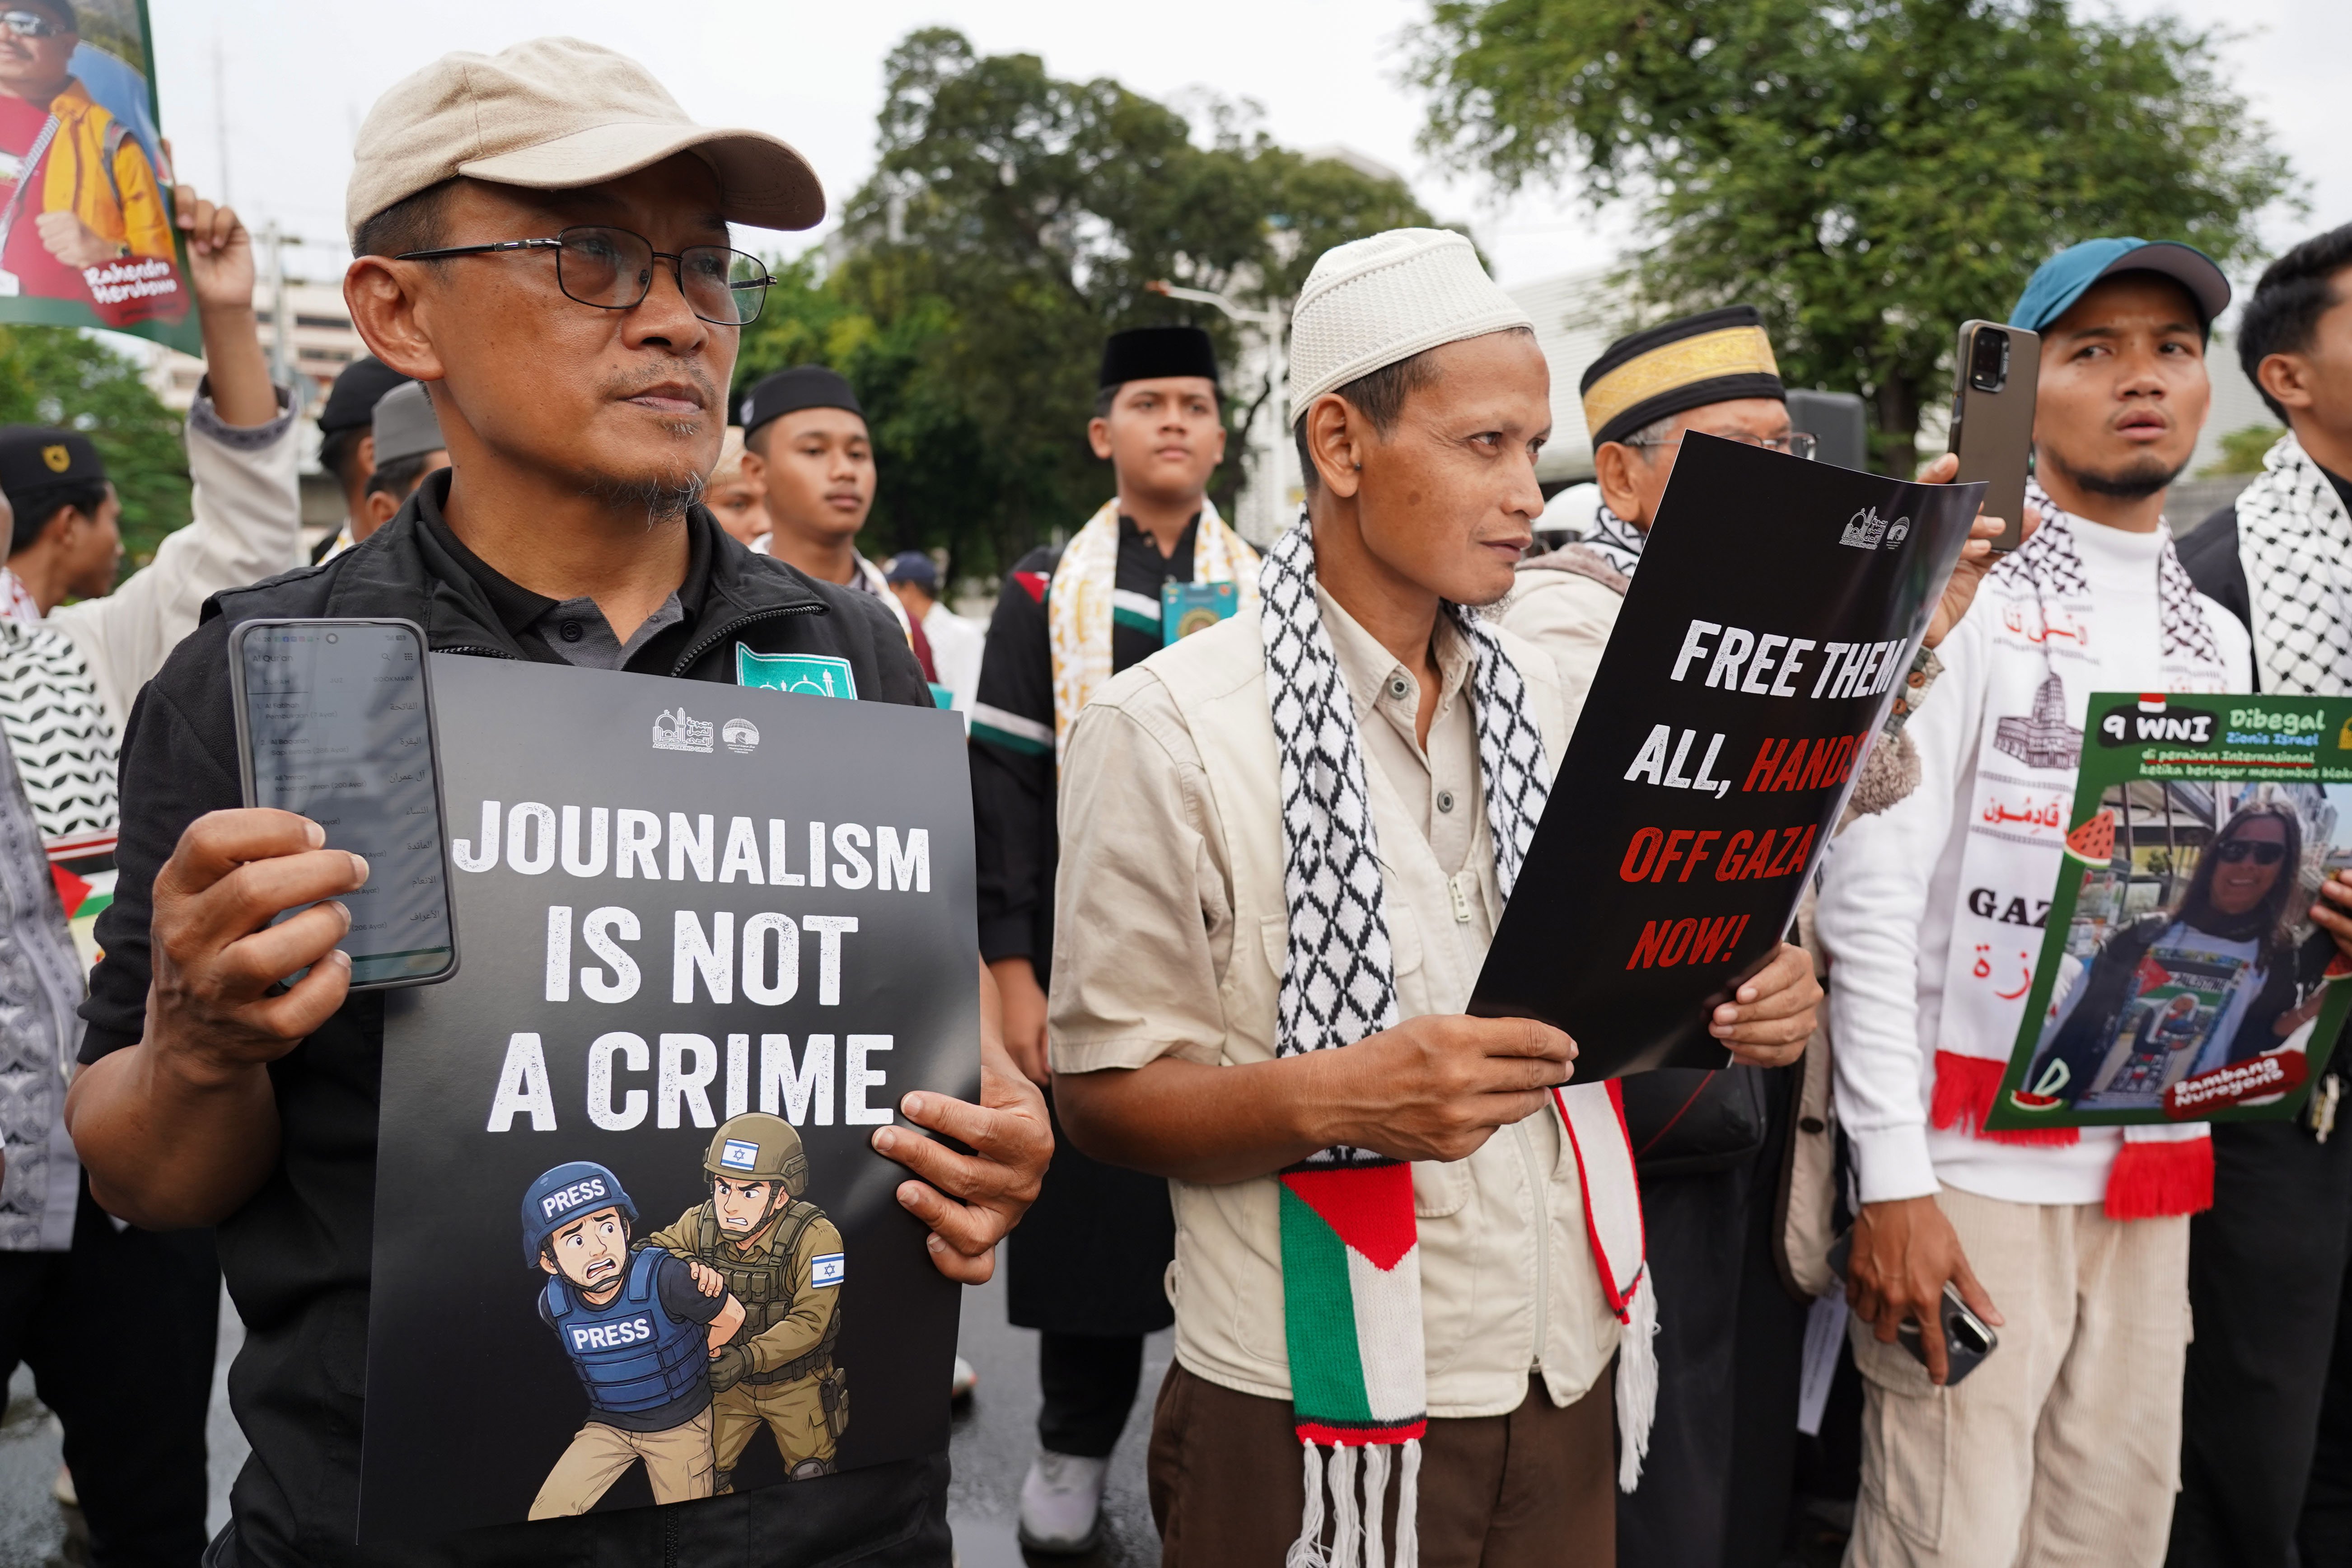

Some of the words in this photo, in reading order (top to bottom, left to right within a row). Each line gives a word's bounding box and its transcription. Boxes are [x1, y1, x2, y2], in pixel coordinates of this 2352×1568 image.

[1671, 619, 1816, 697] FREE
[1810, 638, 1908, 698] THEM
[2103, 715, 2126, 740] 9
[2136, 716, 2212, 742] WNI
[2230, 707, 2326, 735] Dibegal
[400, 736, 421, 747] البقرة
[2226, 731, 2270, 745] Zionis
[2272, 732, 2319, 747] Israel
[1624, 725, 1730, 798] ALL,
[1742, 730, 1869, 791] HANDS
[2141, 748, 2156, 760] di
[2158, 749, 2219, 763] perairan
[2221, 750, 2315, 763] Internasional
[389, 773, 413, 783] عمران
[416, 770, 426, 782] آل
[2139, 763, 2184, 776] ketika
[2185, 764, 2246, 780] berlayar
[2248, 766, 2319, 779] menembus
[332, 782, 347, 790] (200
[348, 781, 367, 789] Ayat)
[322, 818, 341, 826] Ayat)
[368, 850, 387, 858] Ayat)
[453, 800, 931, 893] JOURNALISM
[1620, 827, 1722, 883] OFF
[1715, 824, 1817, 882] GAZA
[361, 886, 380, 895] Ayat)
[1968, 887, 2053, 928] GAZ
[369, 922, 387, 930] Ayat)
[1626, 914, 1751, 970] NOW!
[546, 906, 641, 1003] IS
[673, 911, 859, 1006] NOT
[487, 1033, 557, 1132] A
[588, 1032, 893, 1130] CRIME
[2174, 1058, 2279, 1095] Bambang
[543, 1179, 606, 1217] PRESS
[573, 1318, 650, 1349] PRESS
